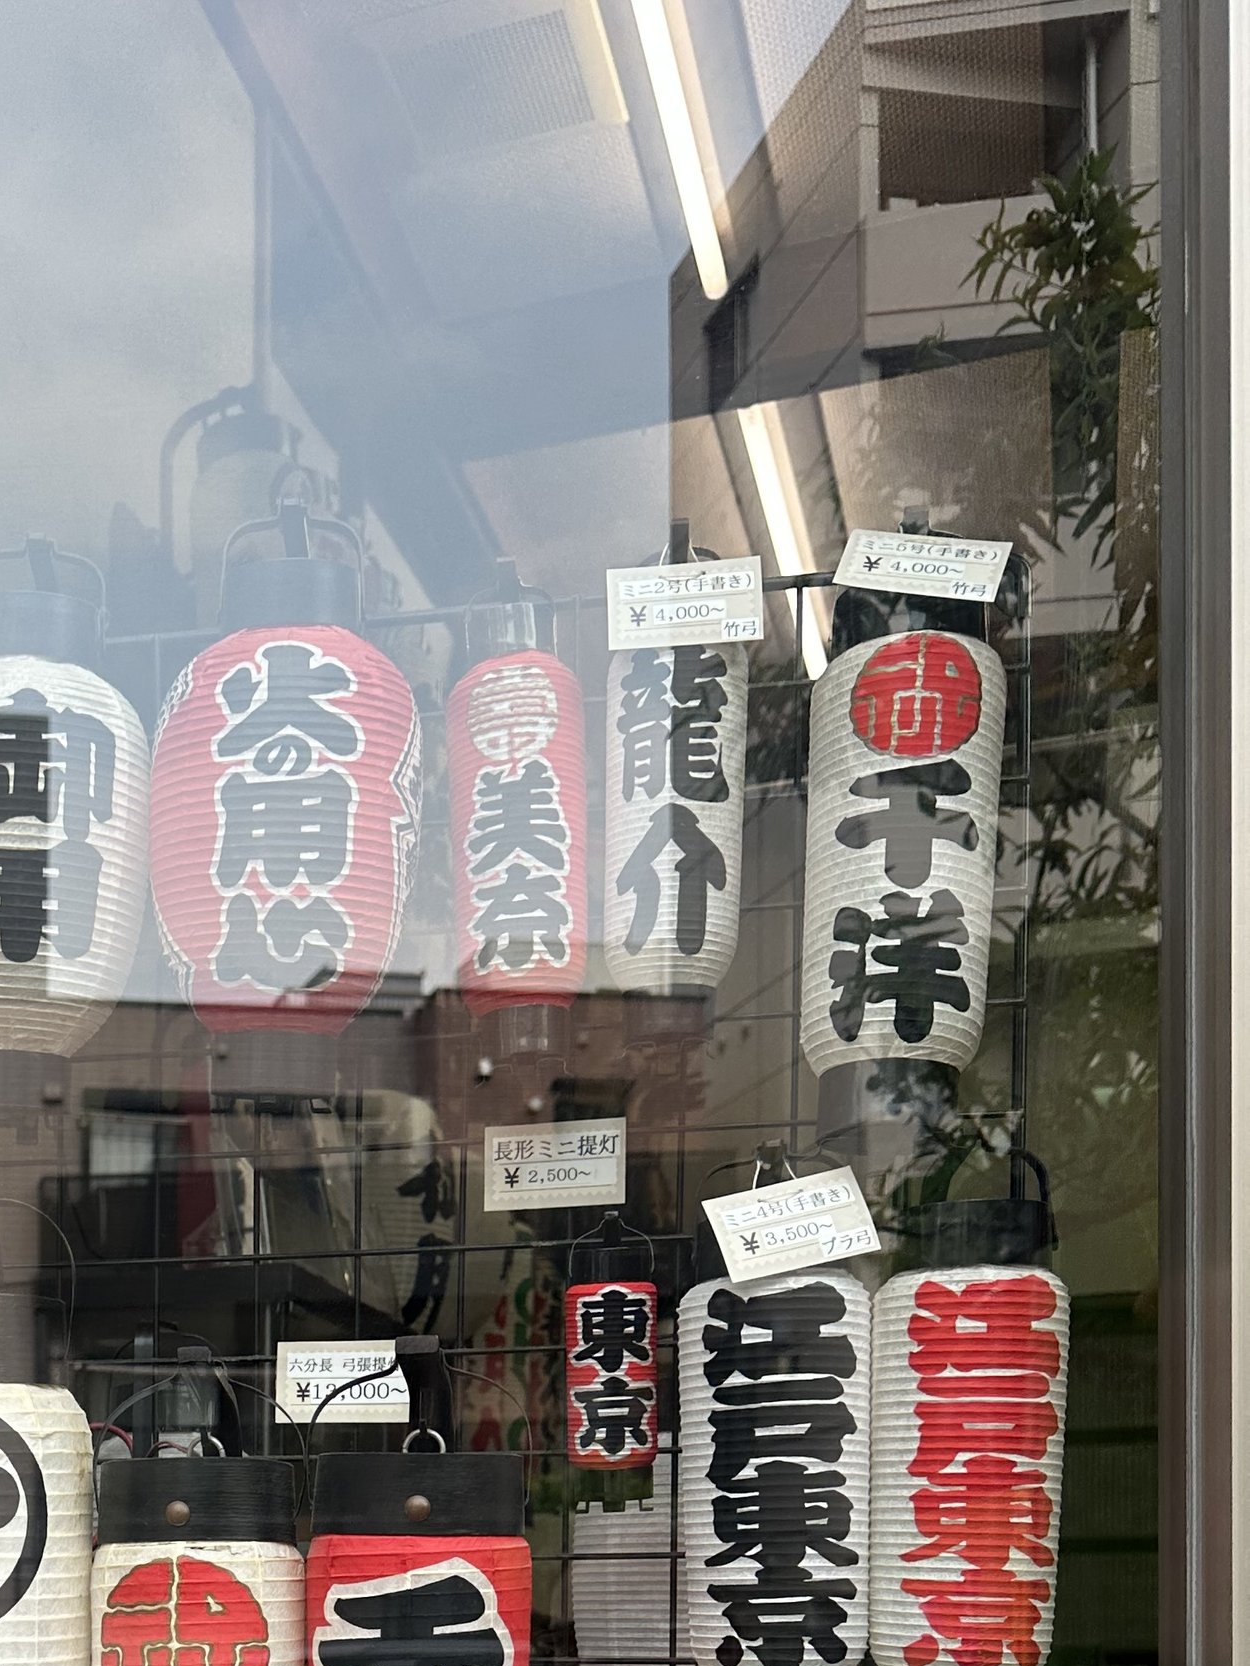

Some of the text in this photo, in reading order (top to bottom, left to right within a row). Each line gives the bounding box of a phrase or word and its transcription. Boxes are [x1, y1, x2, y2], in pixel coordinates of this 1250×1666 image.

[724, 620, 758, 637] 竹弓
[952, 581, 989, 598] 竹弓
[851, 632, 981, 757] 祝
[214, 643, 362, 990] 火の用心
[615, 645, 729, 955] 龍介
[830, 759, 978, 1042] 千洋
[494, 1133, 619, 1163] 長形ミニ提灯
[822, 1229, 872, 1256] プラ弓
[573, 1289, 650, 1454] 東京
